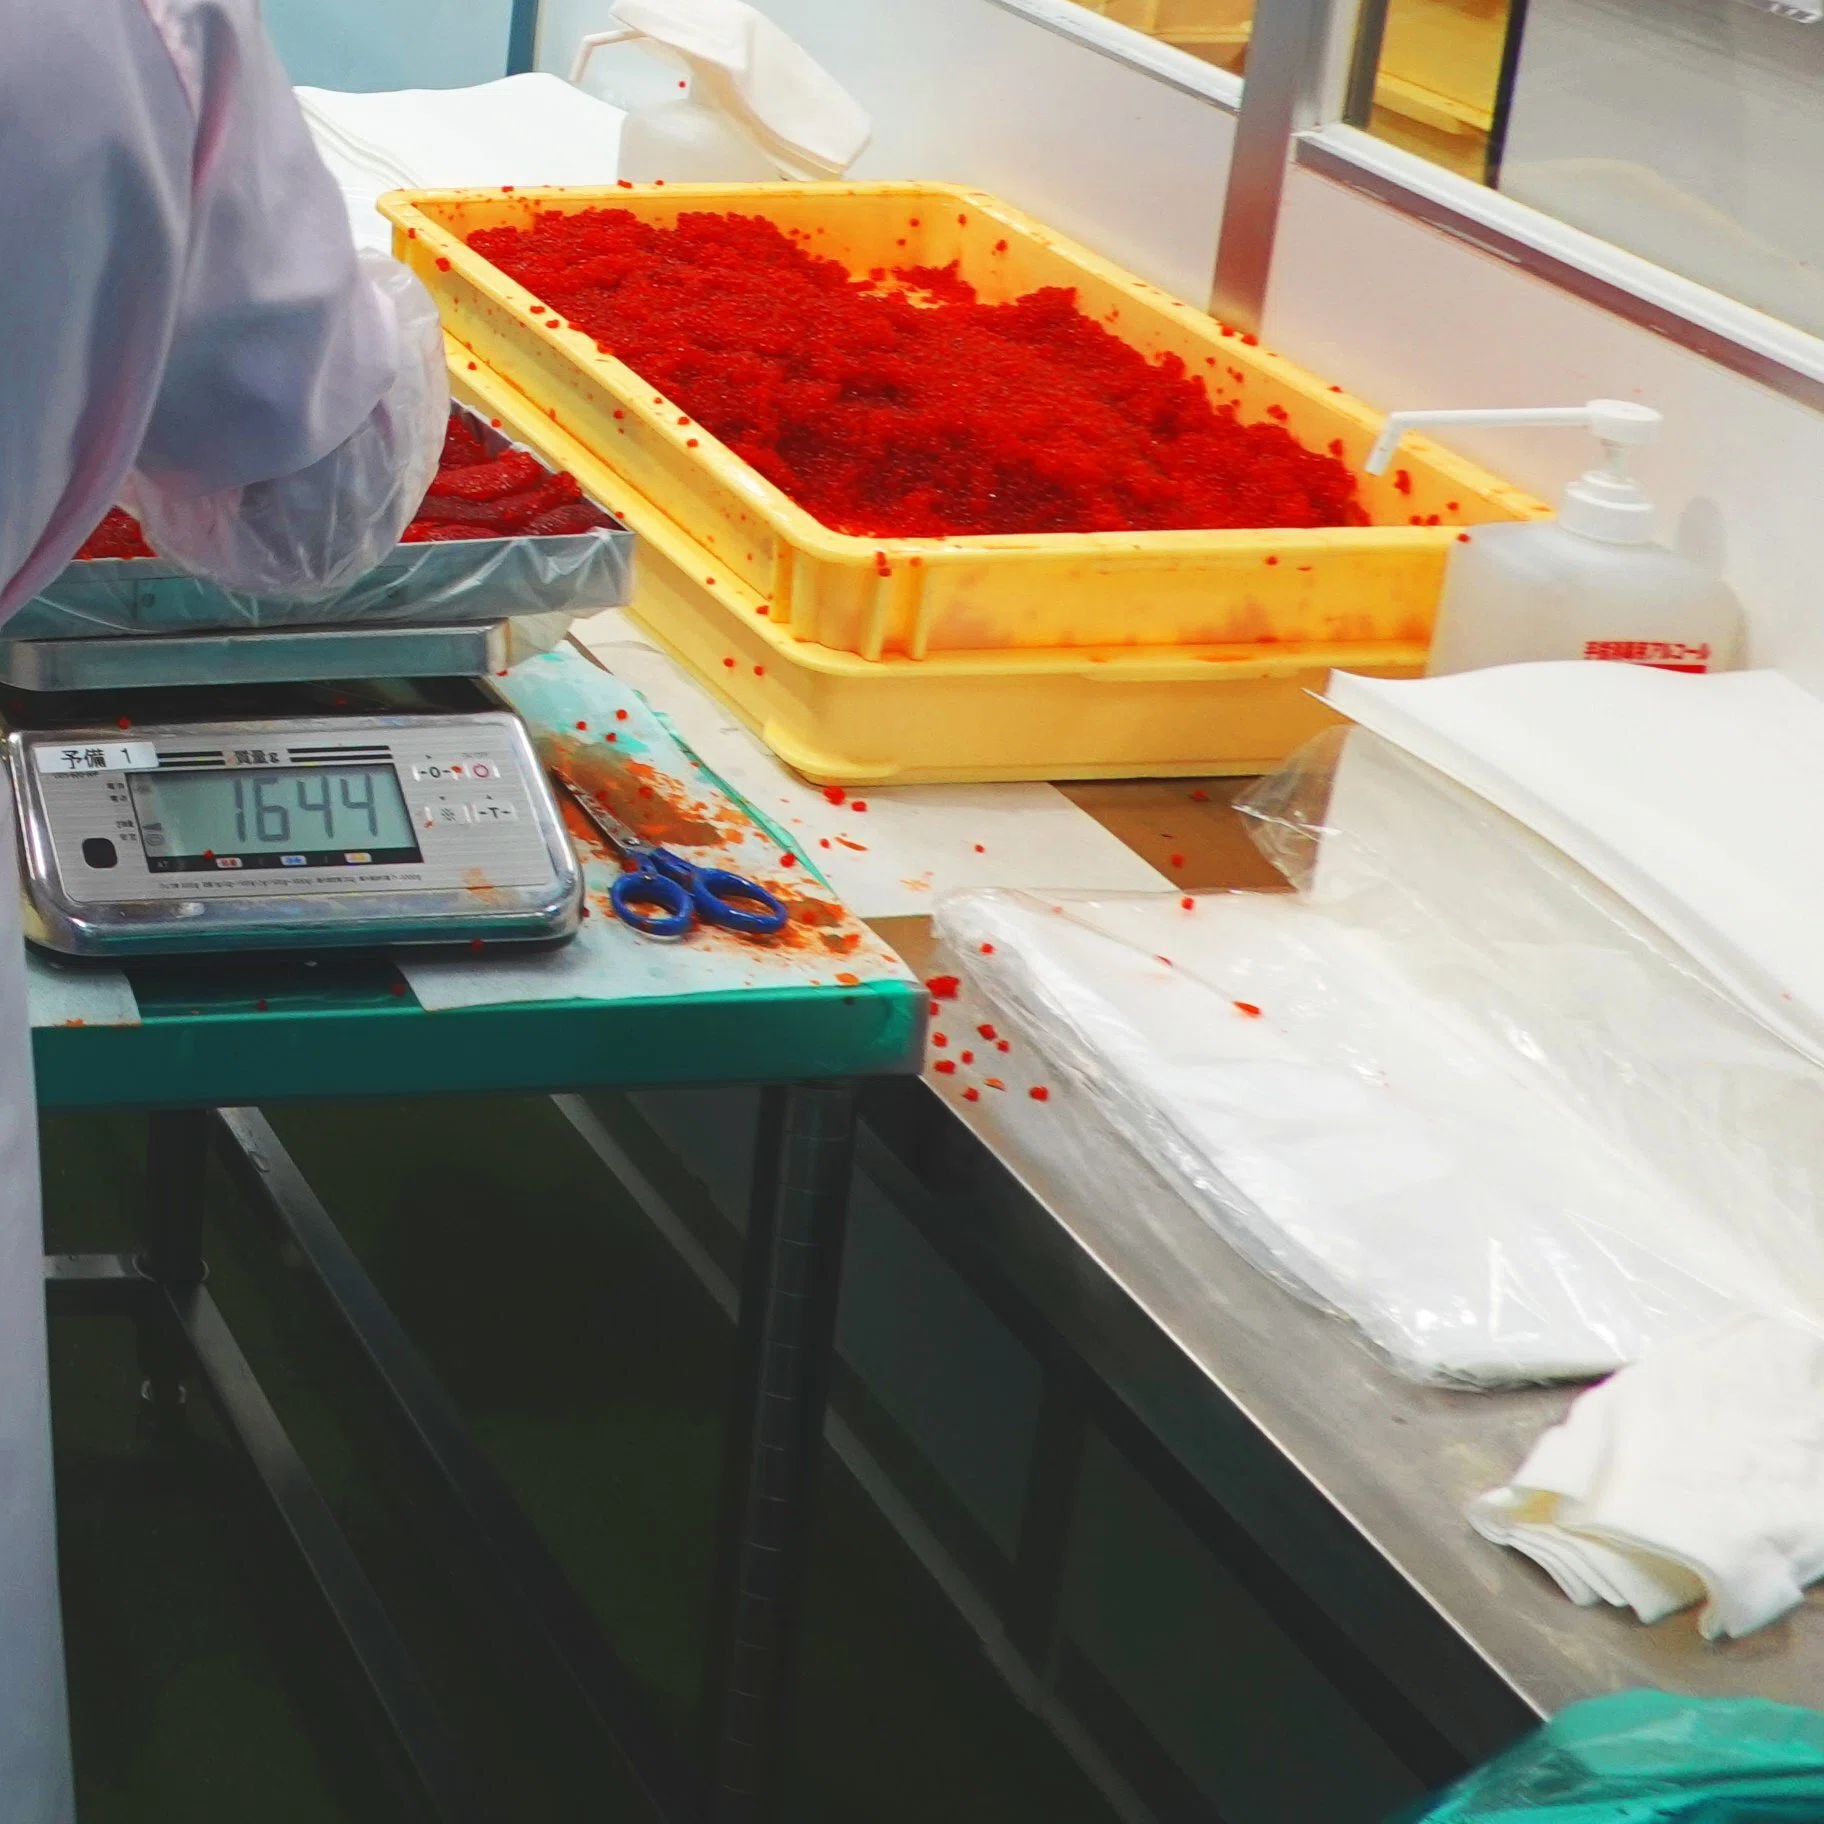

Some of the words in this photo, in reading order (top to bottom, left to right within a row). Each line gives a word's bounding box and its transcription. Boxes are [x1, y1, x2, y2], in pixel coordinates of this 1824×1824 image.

[61, 749, 107, 769] 予備
[120, 748, 132, 764] 1
[234, 773, 378, 843] 1644
